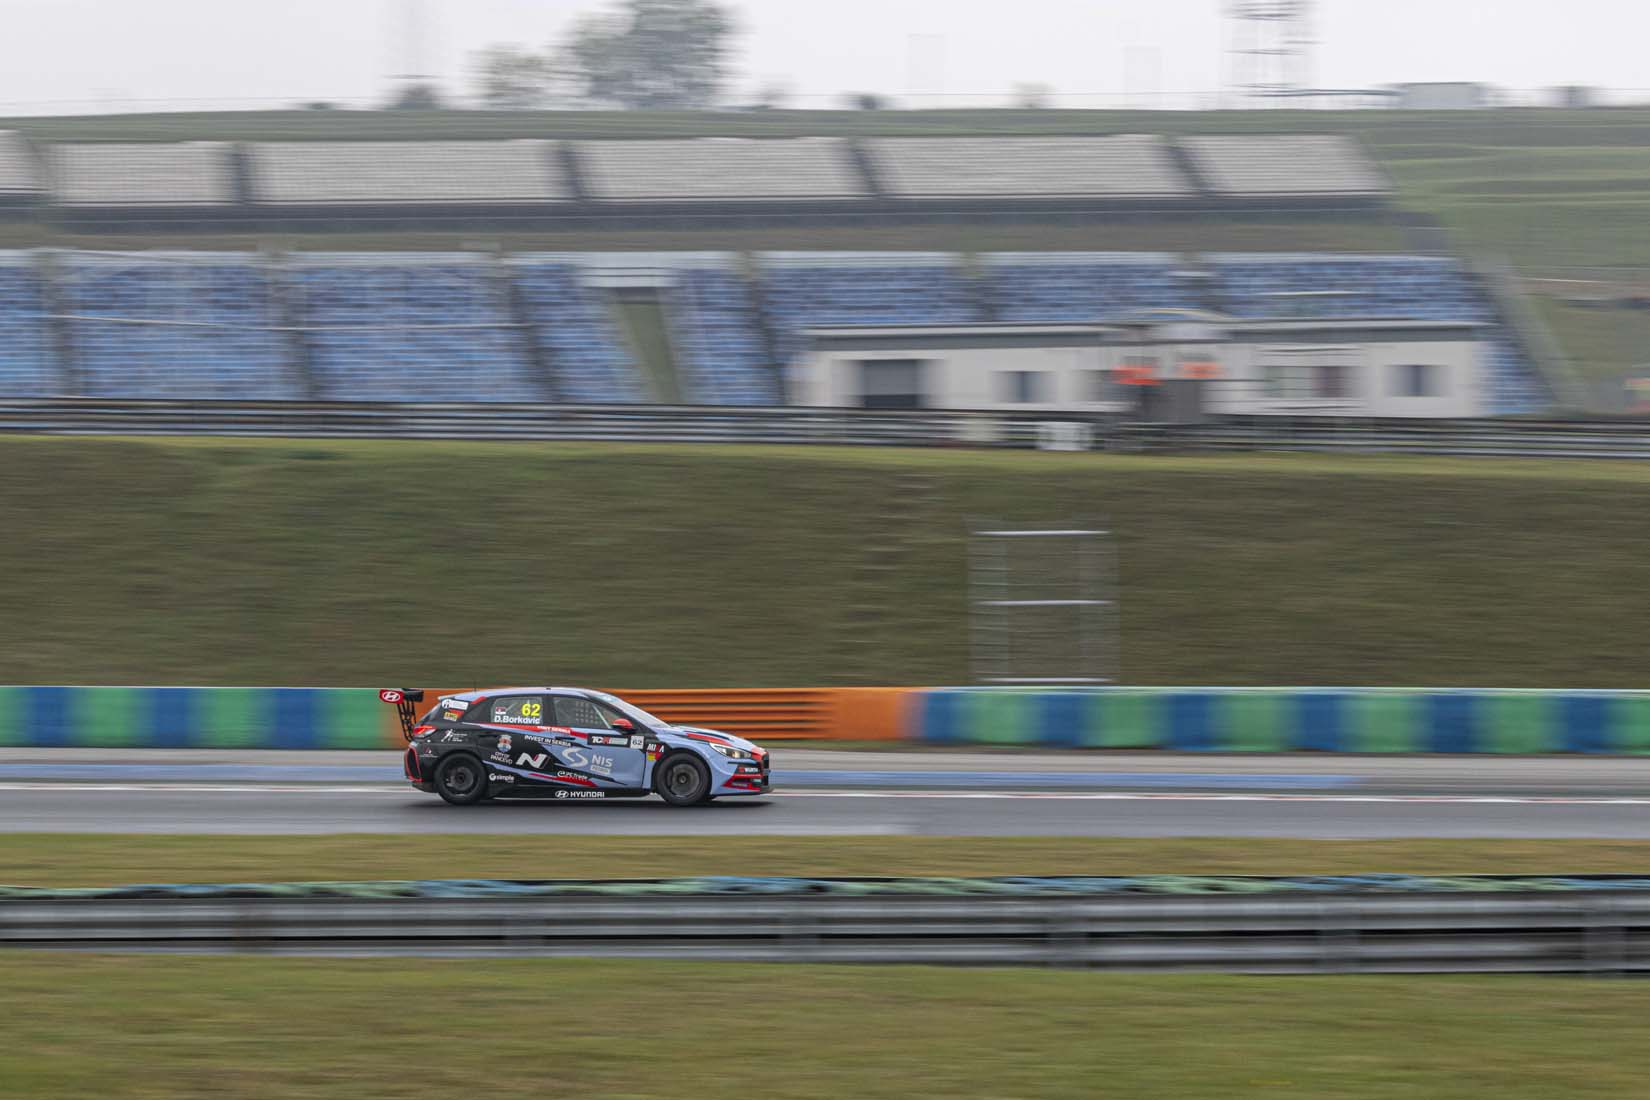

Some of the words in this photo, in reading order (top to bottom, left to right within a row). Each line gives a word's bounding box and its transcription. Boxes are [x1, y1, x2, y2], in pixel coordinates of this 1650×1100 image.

[521, 703, 541, 717] 62
[524, 734, 544, 742] INVEST
[592, 754, 613, 768] NIS
